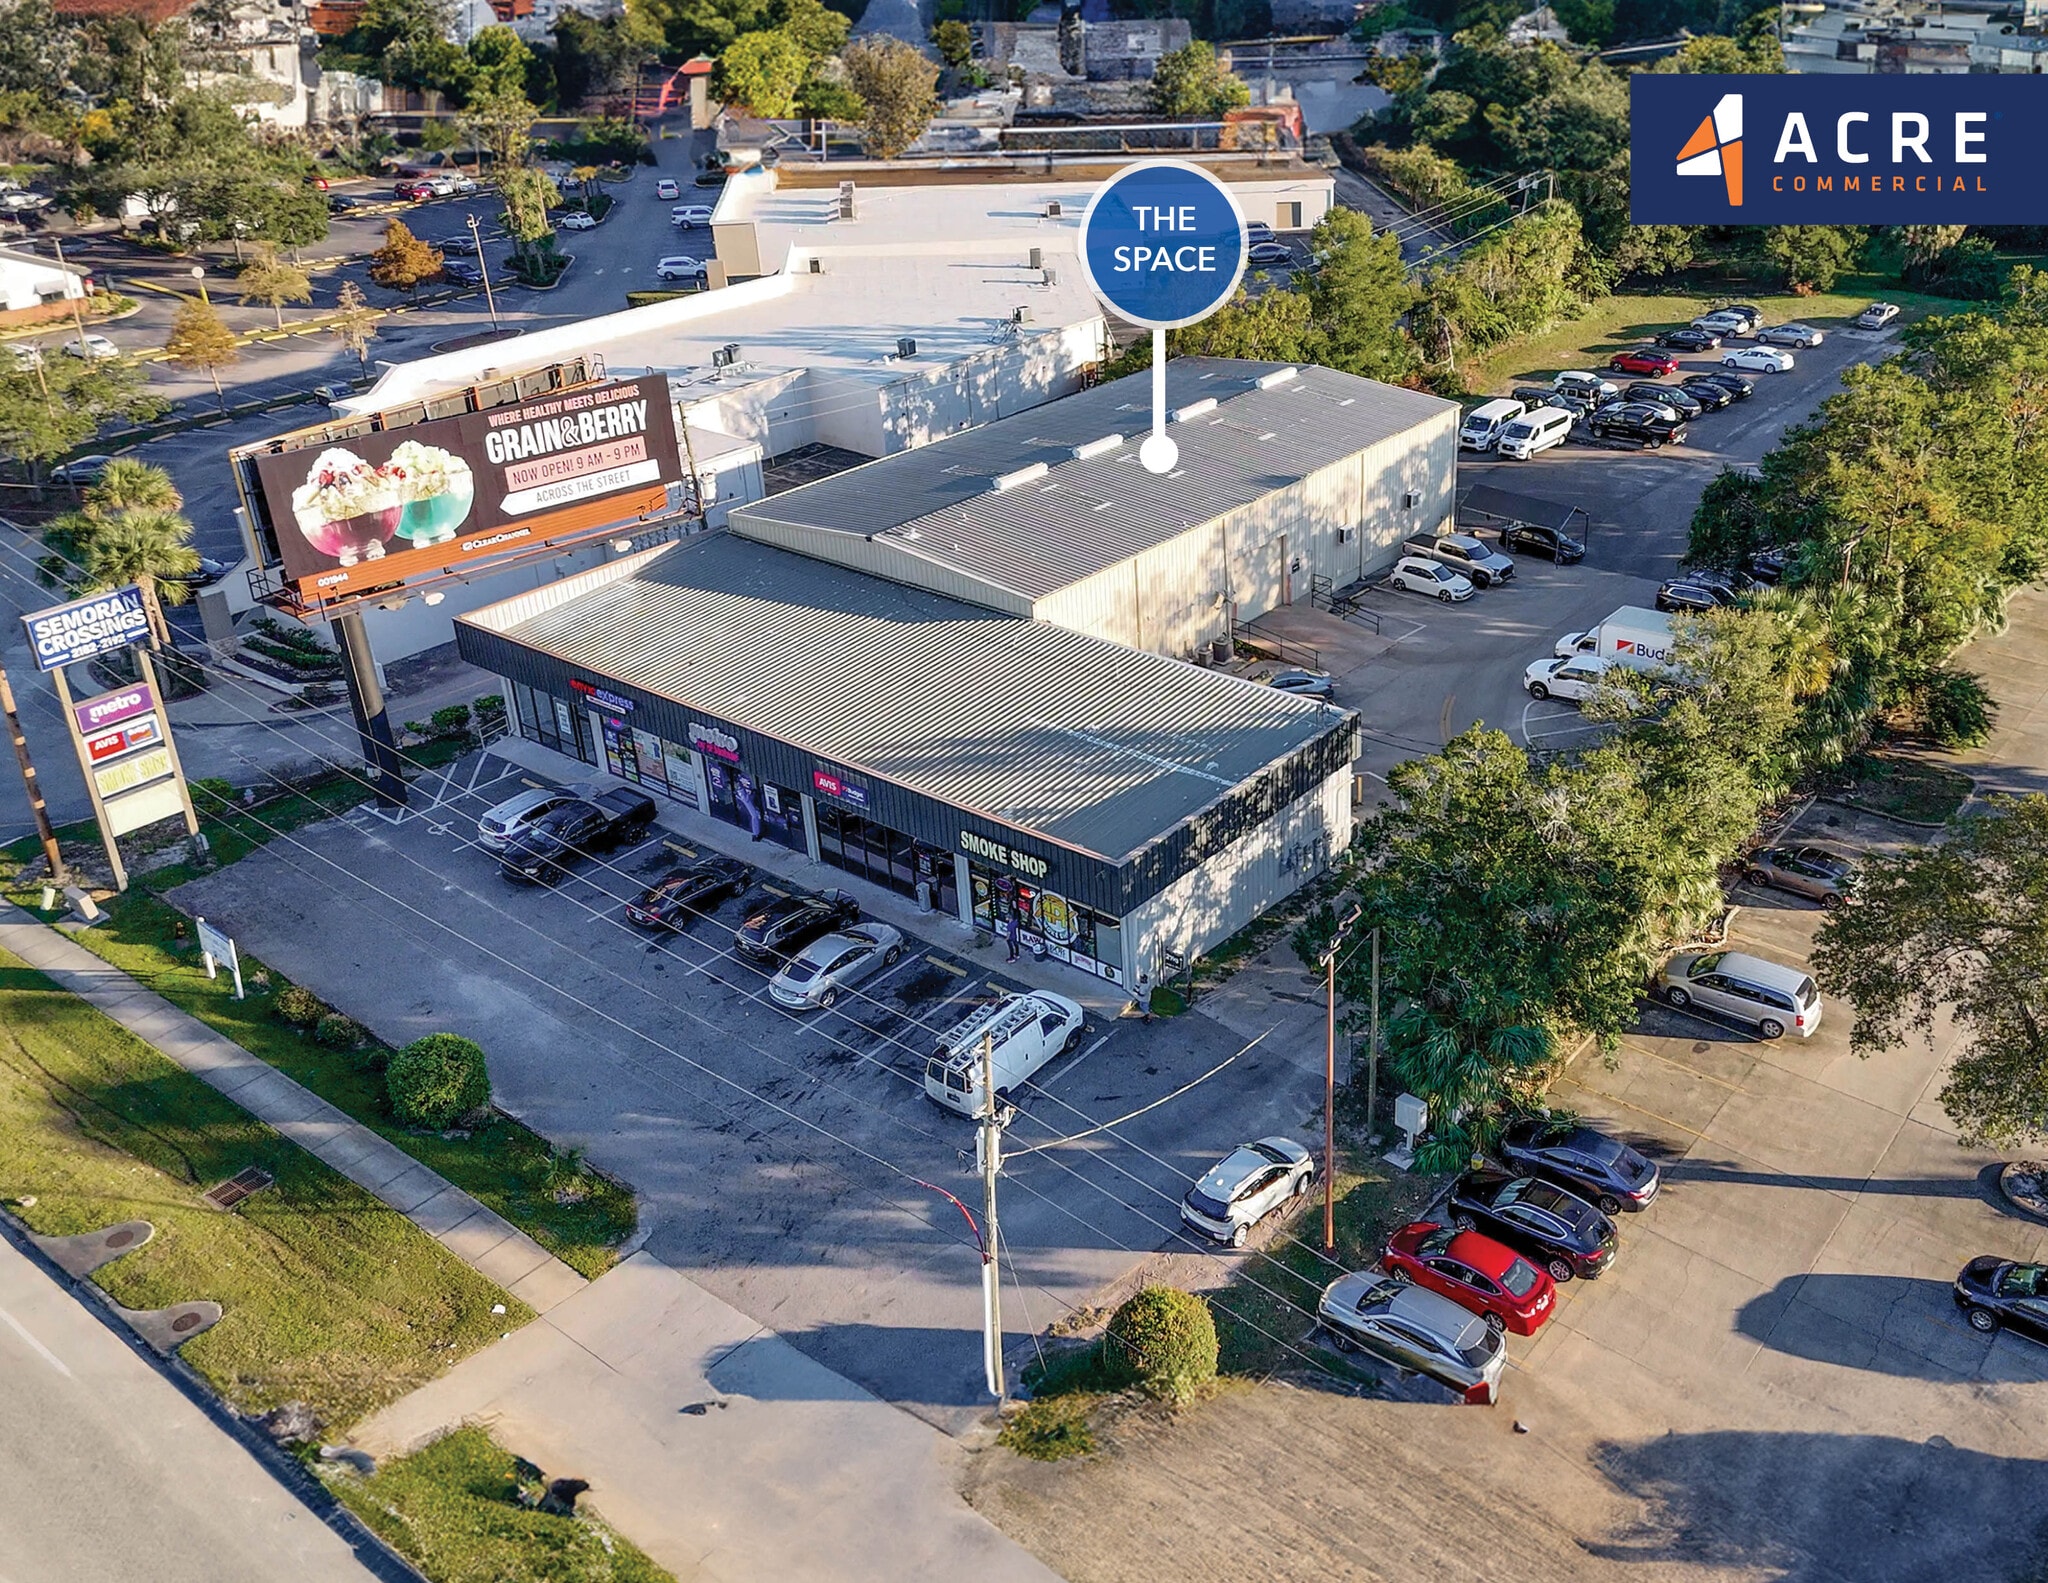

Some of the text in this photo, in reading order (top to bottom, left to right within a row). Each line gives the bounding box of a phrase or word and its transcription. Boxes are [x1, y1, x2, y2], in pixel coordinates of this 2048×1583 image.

[488, 385, 640, 428] WHERE HEALTHY MEETS DELICIOUS
[512, 467, 539, 485] NOW
[542, 459, 574, 478] OPEN!
[576, 457, 584, 470] 9
[587, 453, 604, 468] AM
[613, 447, 621, 460] 9
[624, 444, 641, 458] PM
[536, 470, 631, 502] ACROSS THE STREET
[34, 593, 139, 639] SEMORAN
[38, 608, 147, 656] CROSSINGS
[89, 693, 142, 723] metro
[94, 735, 119, 751] AVIS
[688, 722, 738, 752] metro
[819, 778, 837, 791] AVIS
[960, 830, 1008, 865] SMOKE
[1010, 850, 1048, 878] SHOP
